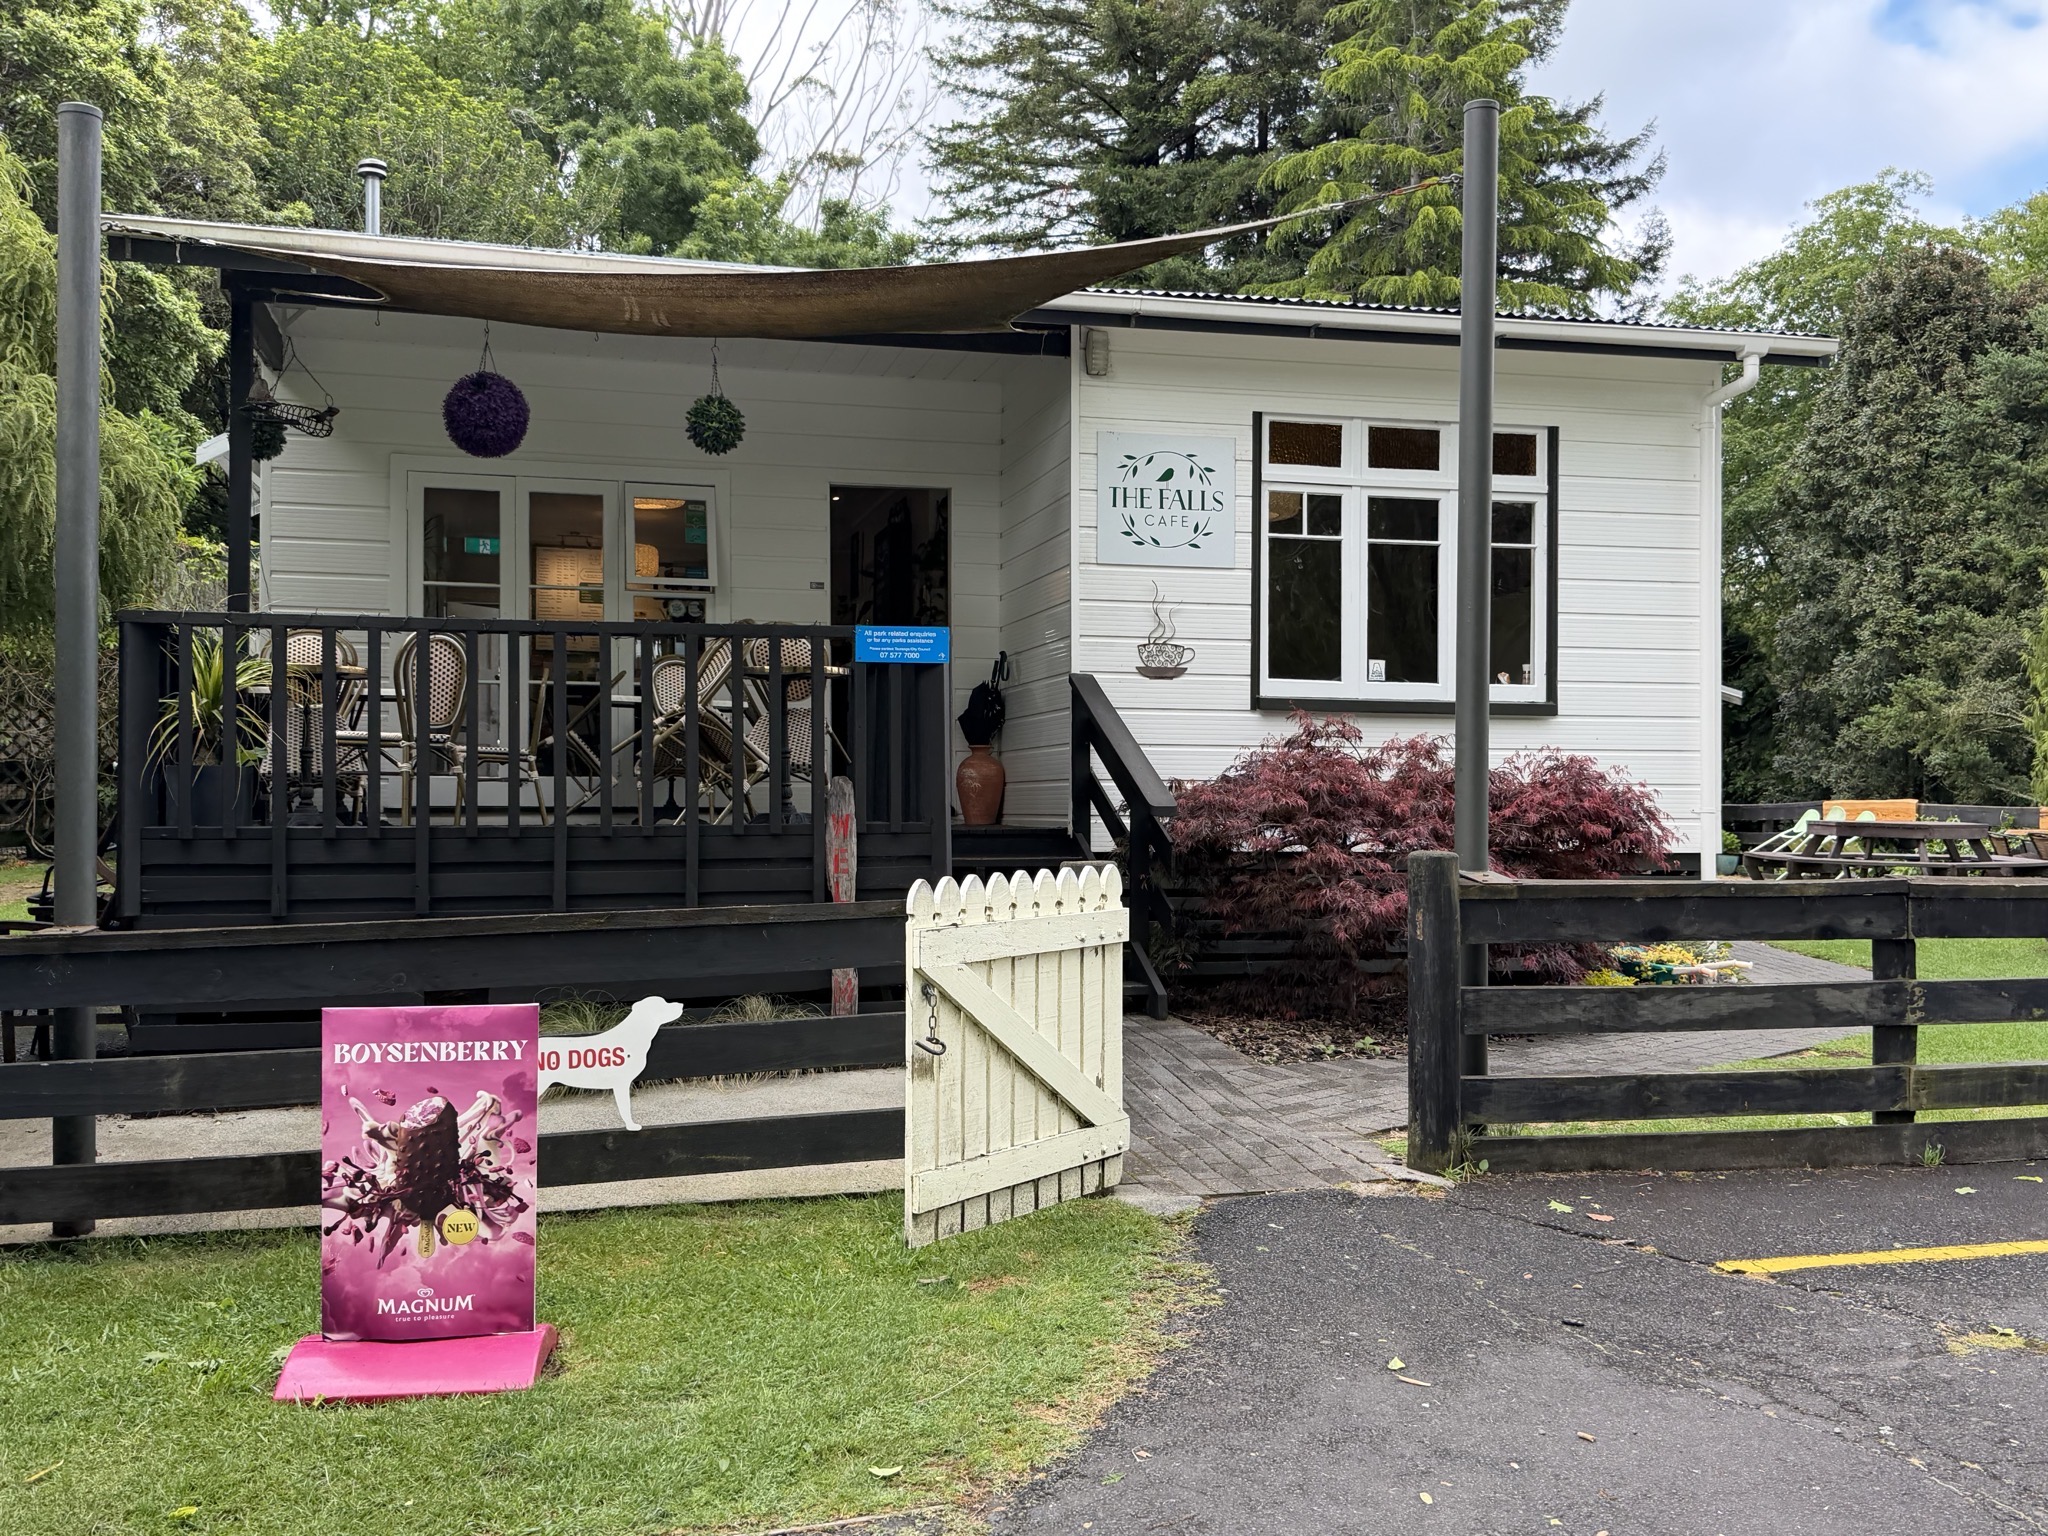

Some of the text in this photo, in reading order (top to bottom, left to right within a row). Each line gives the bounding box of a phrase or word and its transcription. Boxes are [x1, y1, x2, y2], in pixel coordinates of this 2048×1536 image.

[1108, 486, 1224, 512] THE FALLS
[1144, 514, 1189, 528] CAFE
[873, 630, 887, 639] park
[909, 631, 937, 639] enquiries
[333, 1039, 529, 1064] BOYSENBERRY
[568, 1047, 625, 1069] DOGS
[447, 1222, 476, 1233] NEW
[377, 1294, 474, 1314] MAGNUM
[424, 1314, 455, 1322] pleasure
